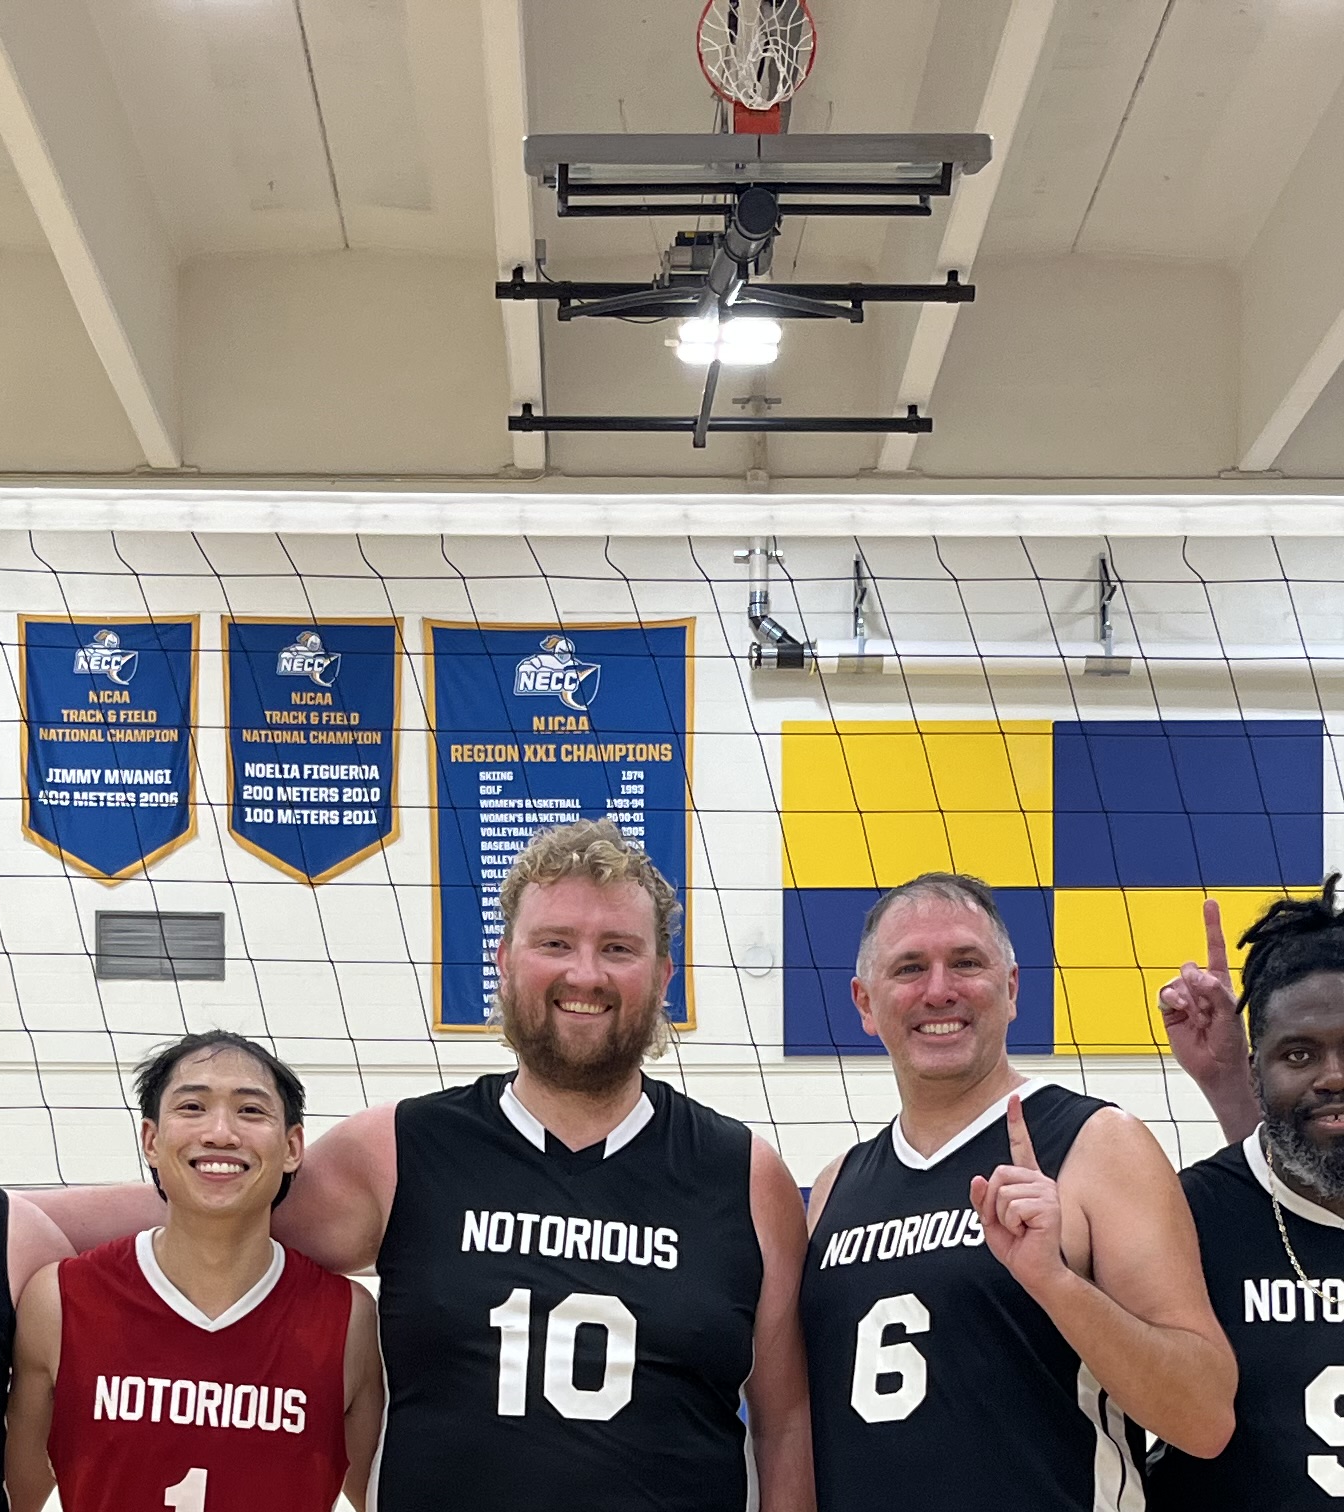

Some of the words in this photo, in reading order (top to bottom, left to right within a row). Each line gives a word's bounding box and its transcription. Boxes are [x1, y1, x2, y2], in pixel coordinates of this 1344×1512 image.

[77, 656, 121, 670] NECC
[280, 658, 324, 672] NECC
[518, 671, 580, 691] NECC
[88, 690, 131, 704] NJCAA
[291, 691, 333, 705] NJCAA
[61, 709, 105, 723] TRACK
[107, 710, 118, 723] &
[119, 710, 158, 723] FIELD
[264, 710, 307, 725] TRACK
[309, 711, 320, 725] &
[321, 711, 360, 726] FIELD
[532, 715, 591, 734] NJCAA
[39, 727, 105, 742] NATIONAL
[107, 728, 179, 743] CHAMPION
[242, 729, 307, 744] NATIONAL
[309, 730, 382, 745] CHAMPION
[450, 744, 519, 762] REGION
[523, 744, 557, 762] XXI
[560, 744, 673, 762] CHAMPIONS
[45, 768, 102, 784] JIMMY
[104, 769, 172, 785] MWANGI
[244, 762, 301, 779] NOELIA
[303, 763, 380, 780] FIGUEROA
[479, 770, 514, 781] SKIING
[242, 785, 274, 801] 200
[277, 786, 339, 802] METERS
[342, 787, 381, 803] 2010
[479, 785, 503, 795] GOLF
[620, 784, 645, 795] 1993
[73, 791, 137, 807] METERS
[479, 798, 524, 809] WOMEN'S
[524, 798, 582, 809] BASKETBALL
[244, 807, 274, 824] 100
[277, 808, 340, 825] METERS
[342, 809, 378, 826] 2011
[479, 812, 524, 823] WOMEN'S
[525, 812, 580, 823] BASKETBALL
[480, 826, 534, 837] VOLLEYBALL
[480, 841, 525, 851] BASEBALL
[481, 854, 516, 865] VOLLEY
[460, 1209, 679, 1270] NOTORIOUS
[819, 1208, 986, 1271] NOTORIOUS
[489, 1288, 638, 1422] 10
[850, 1292, 932, 1424] 6
[93, 1374, 307, 1434] NOTORIOUS
